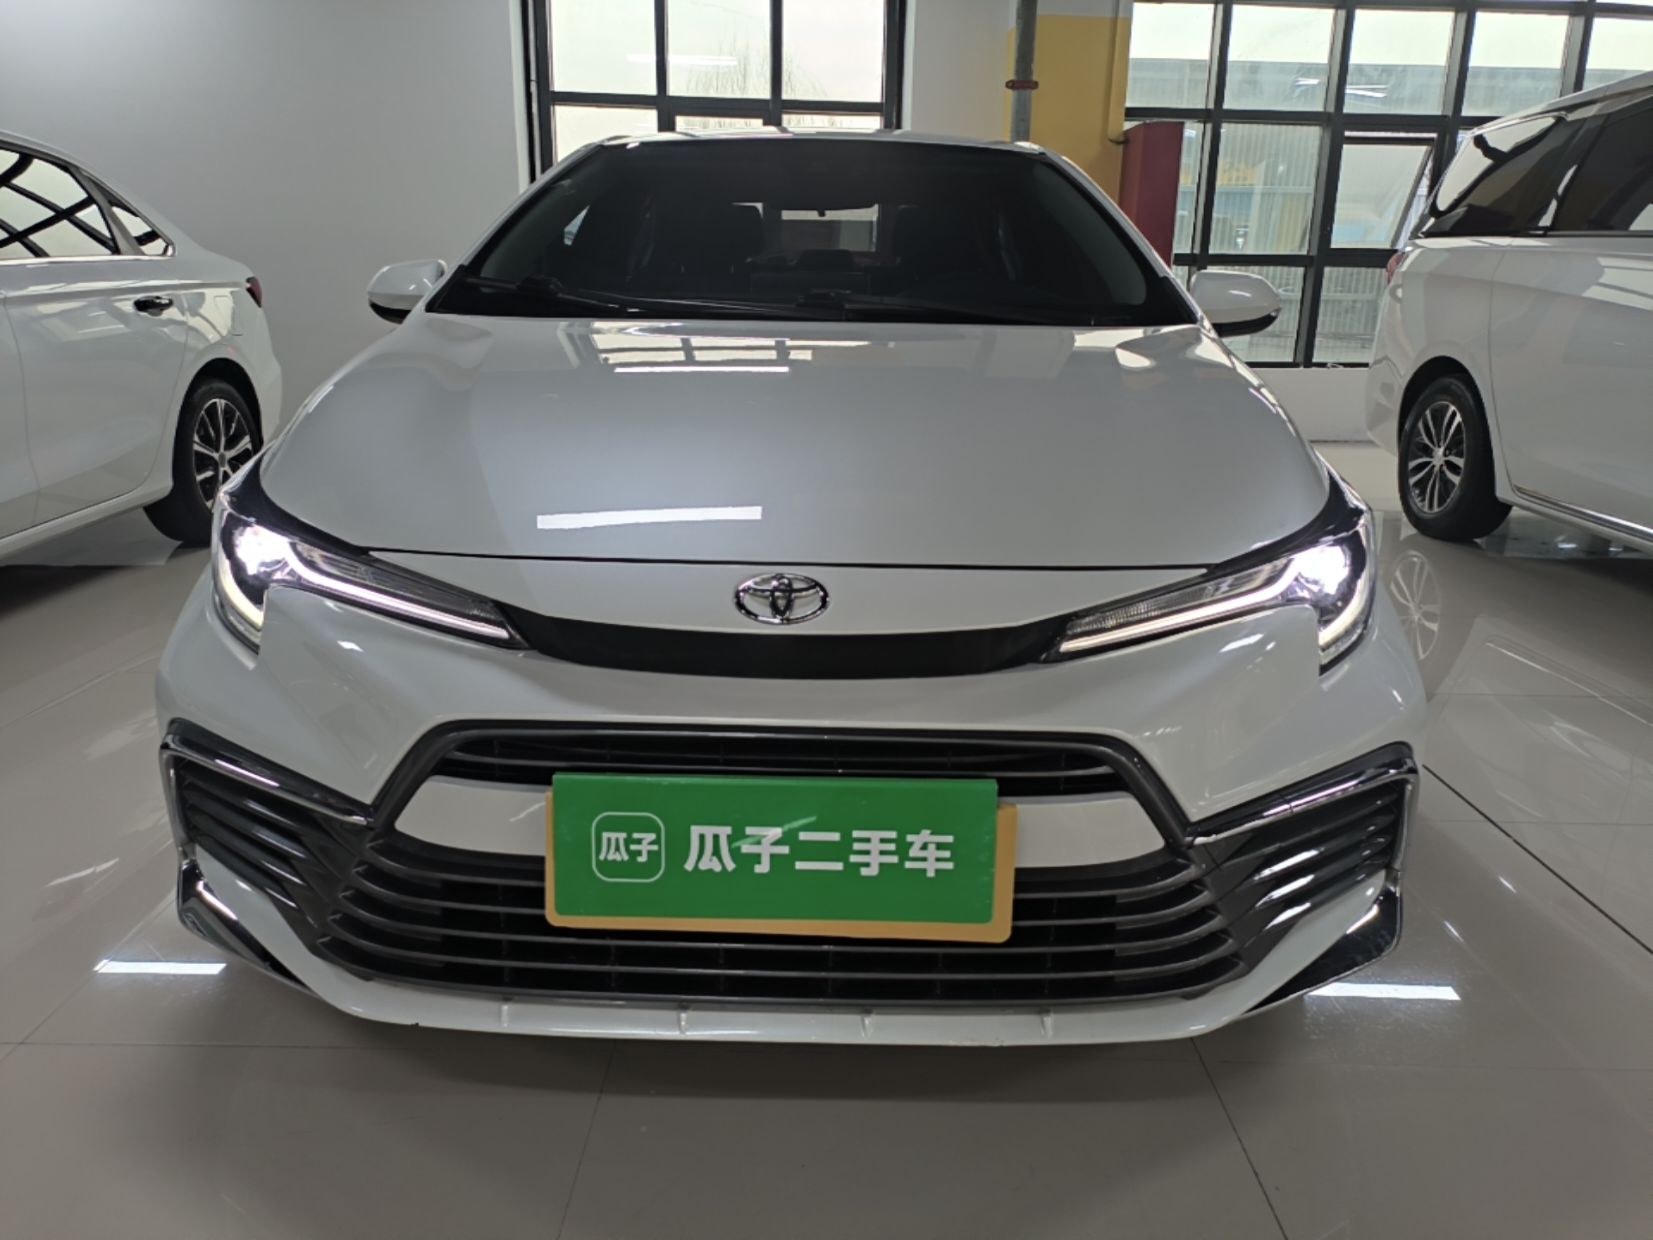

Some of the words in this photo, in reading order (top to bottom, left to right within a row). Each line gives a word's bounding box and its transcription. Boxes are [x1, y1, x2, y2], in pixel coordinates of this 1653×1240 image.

[599, 831, 658, 863] 瓜子
[684, 825, 955, 877] 瓜子二手车
